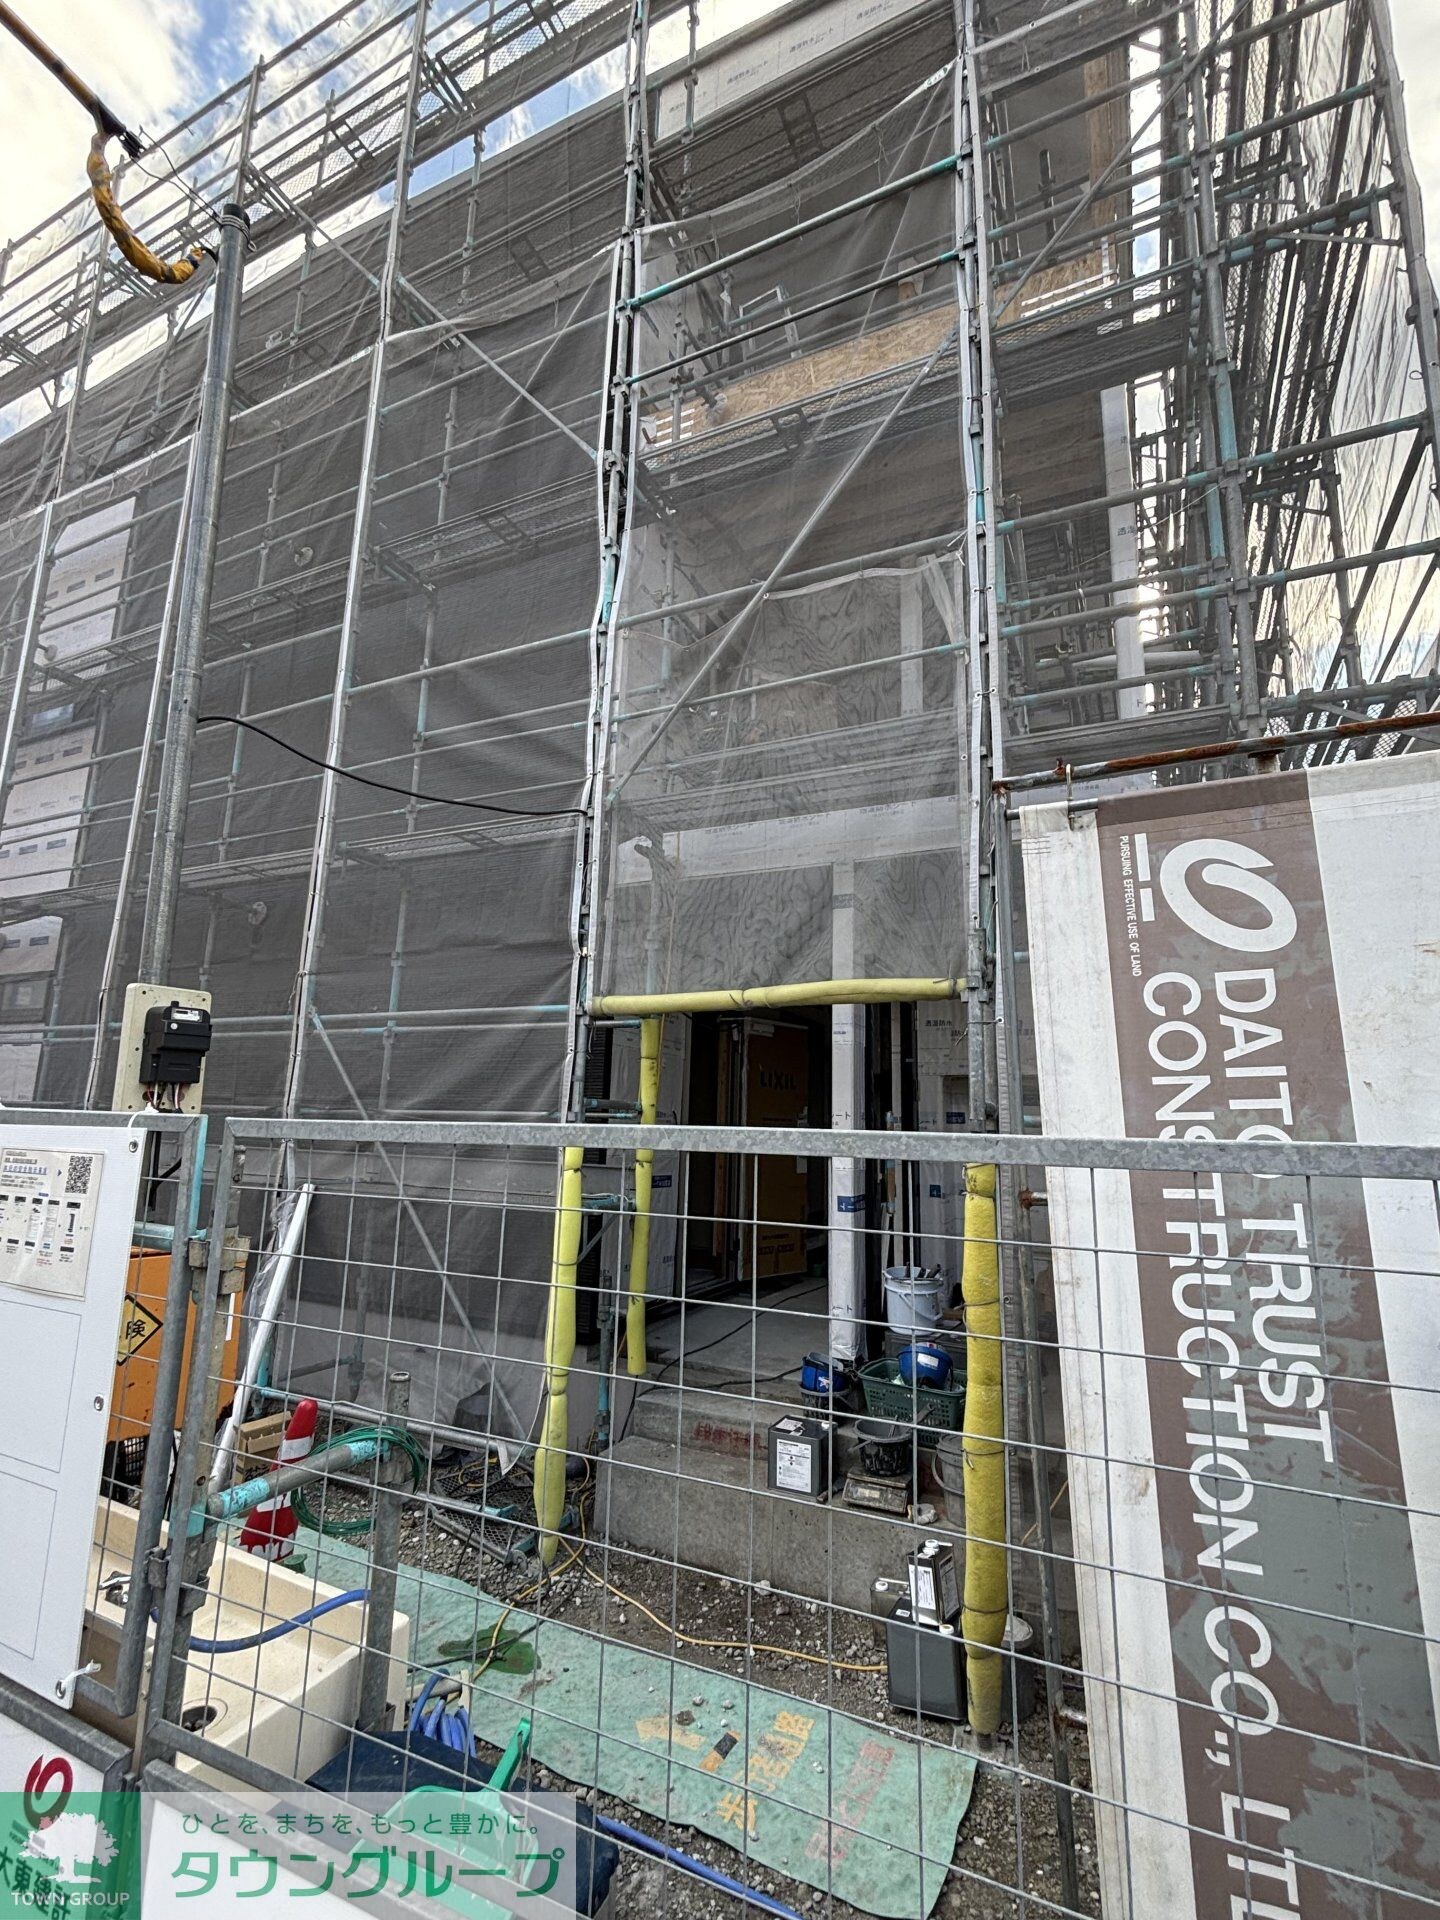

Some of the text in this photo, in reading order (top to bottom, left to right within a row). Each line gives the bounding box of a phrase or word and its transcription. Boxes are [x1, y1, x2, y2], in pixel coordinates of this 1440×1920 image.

[1120, 835, 1142, 977] PURSUING EFFECTIVE USE OF LAND
[760, 1071, 797, 1090] LIXIL
[122, 1318, 147, 1340] 険
[1242, 1203, 1334, 1463] TRUST
[1204, 1606, 1279, 1766] CO.,
